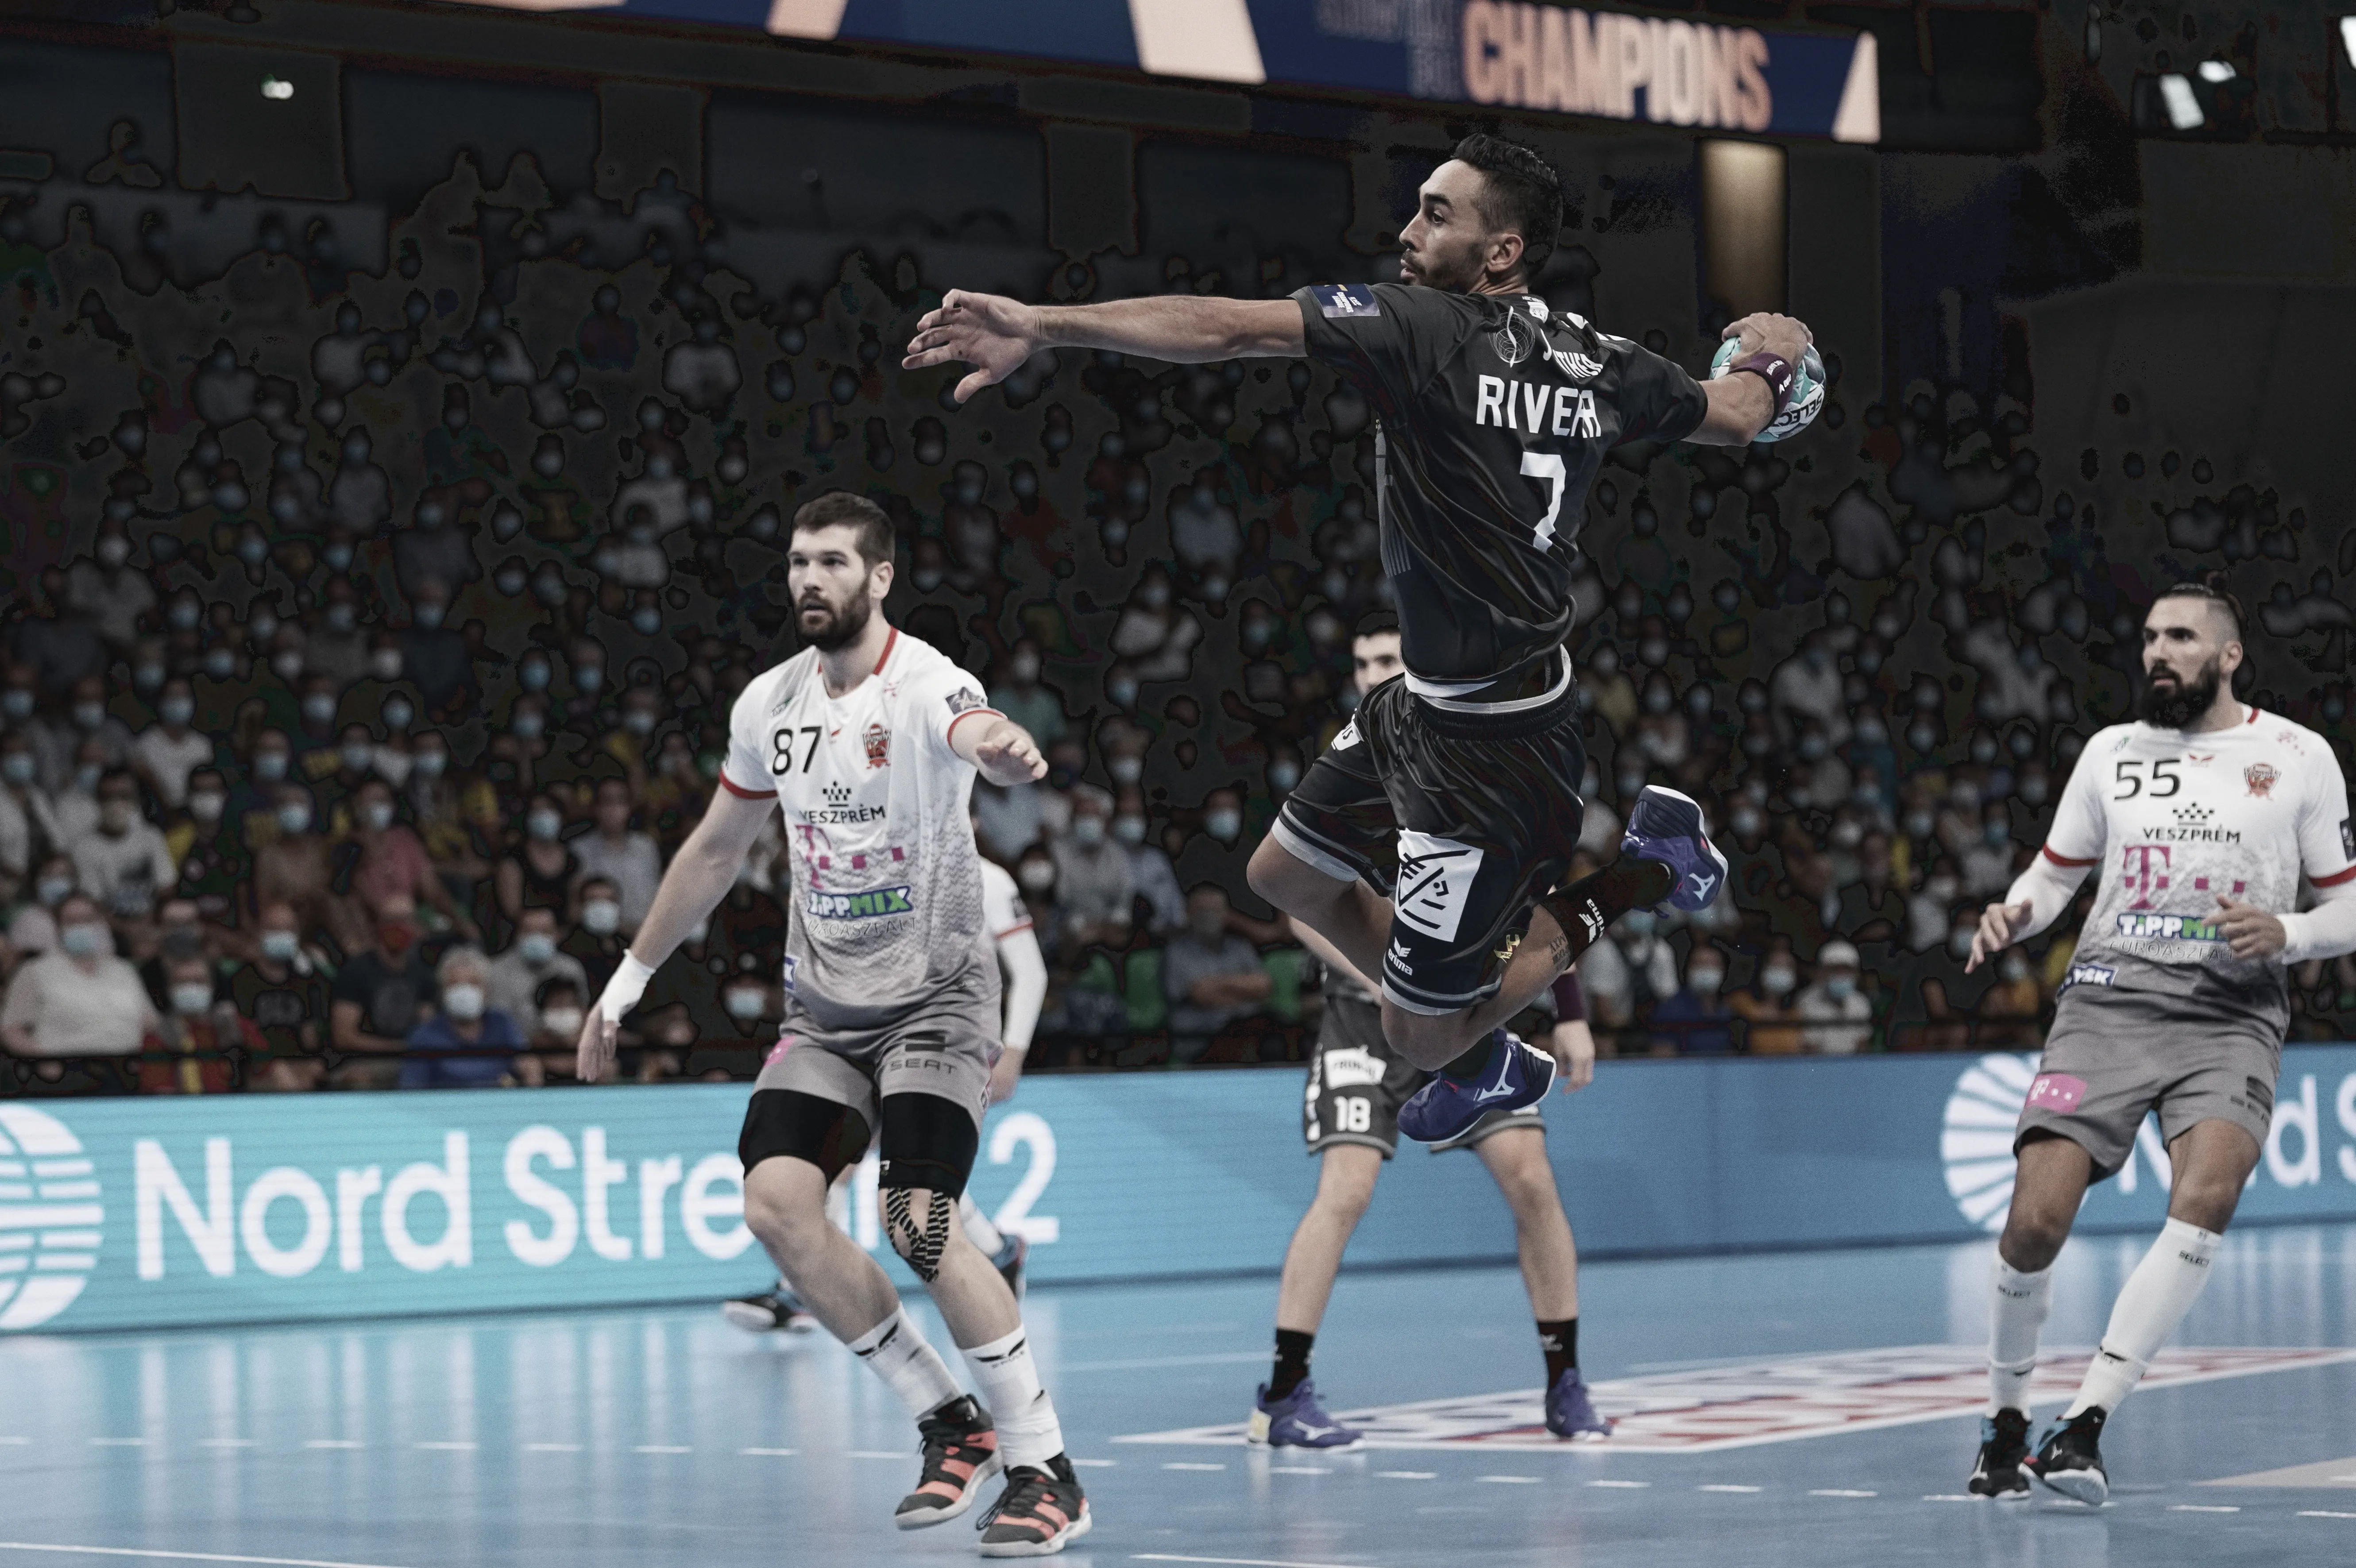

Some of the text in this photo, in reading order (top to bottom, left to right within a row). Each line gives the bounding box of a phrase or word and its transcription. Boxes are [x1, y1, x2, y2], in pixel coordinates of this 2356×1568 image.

[1464, 0, 1773, 132] CHAMPIONS
[1520, 452, 1566, 554] 7
[772, 726, 822, 776] 87
[2114, 759, 2181, 800] 55
[2143, 823, 2240, 844] VESZPRÉM
[1388, 948, 1413, 976] erima
[890, 1057, 957, 1074] SEAT
[1334, 1096, 1371, 1132] 18
[134, 1129, 472, 1280] Nord
[989, 1112, 1060, 1244] 2
